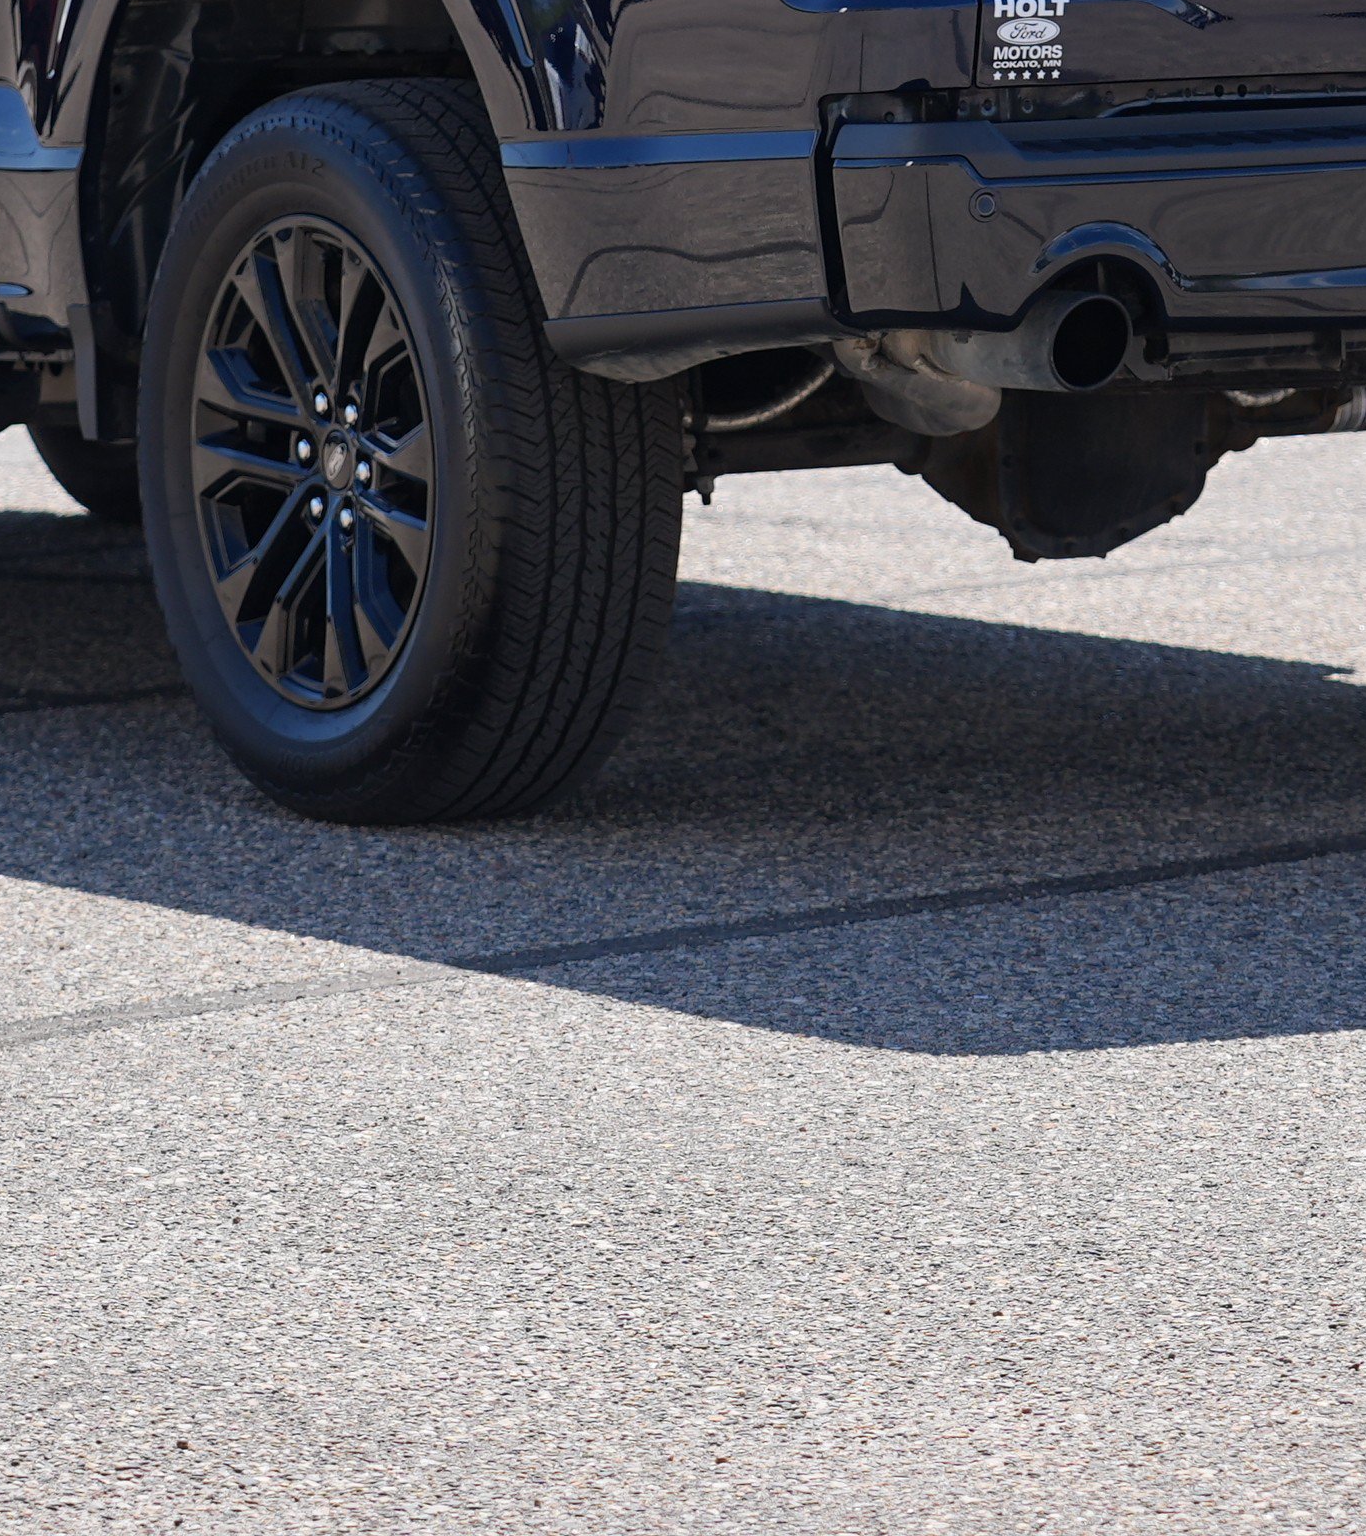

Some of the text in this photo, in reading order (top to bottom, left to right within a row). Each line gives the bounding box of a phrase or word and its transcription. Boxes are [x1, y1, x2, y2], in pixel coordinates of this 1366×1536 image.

[1009, 22, 1047, 40] Ford
[992, 45, 1063, 60] MOTORS
[992, 59, 1062, 69] COKATO, MN
